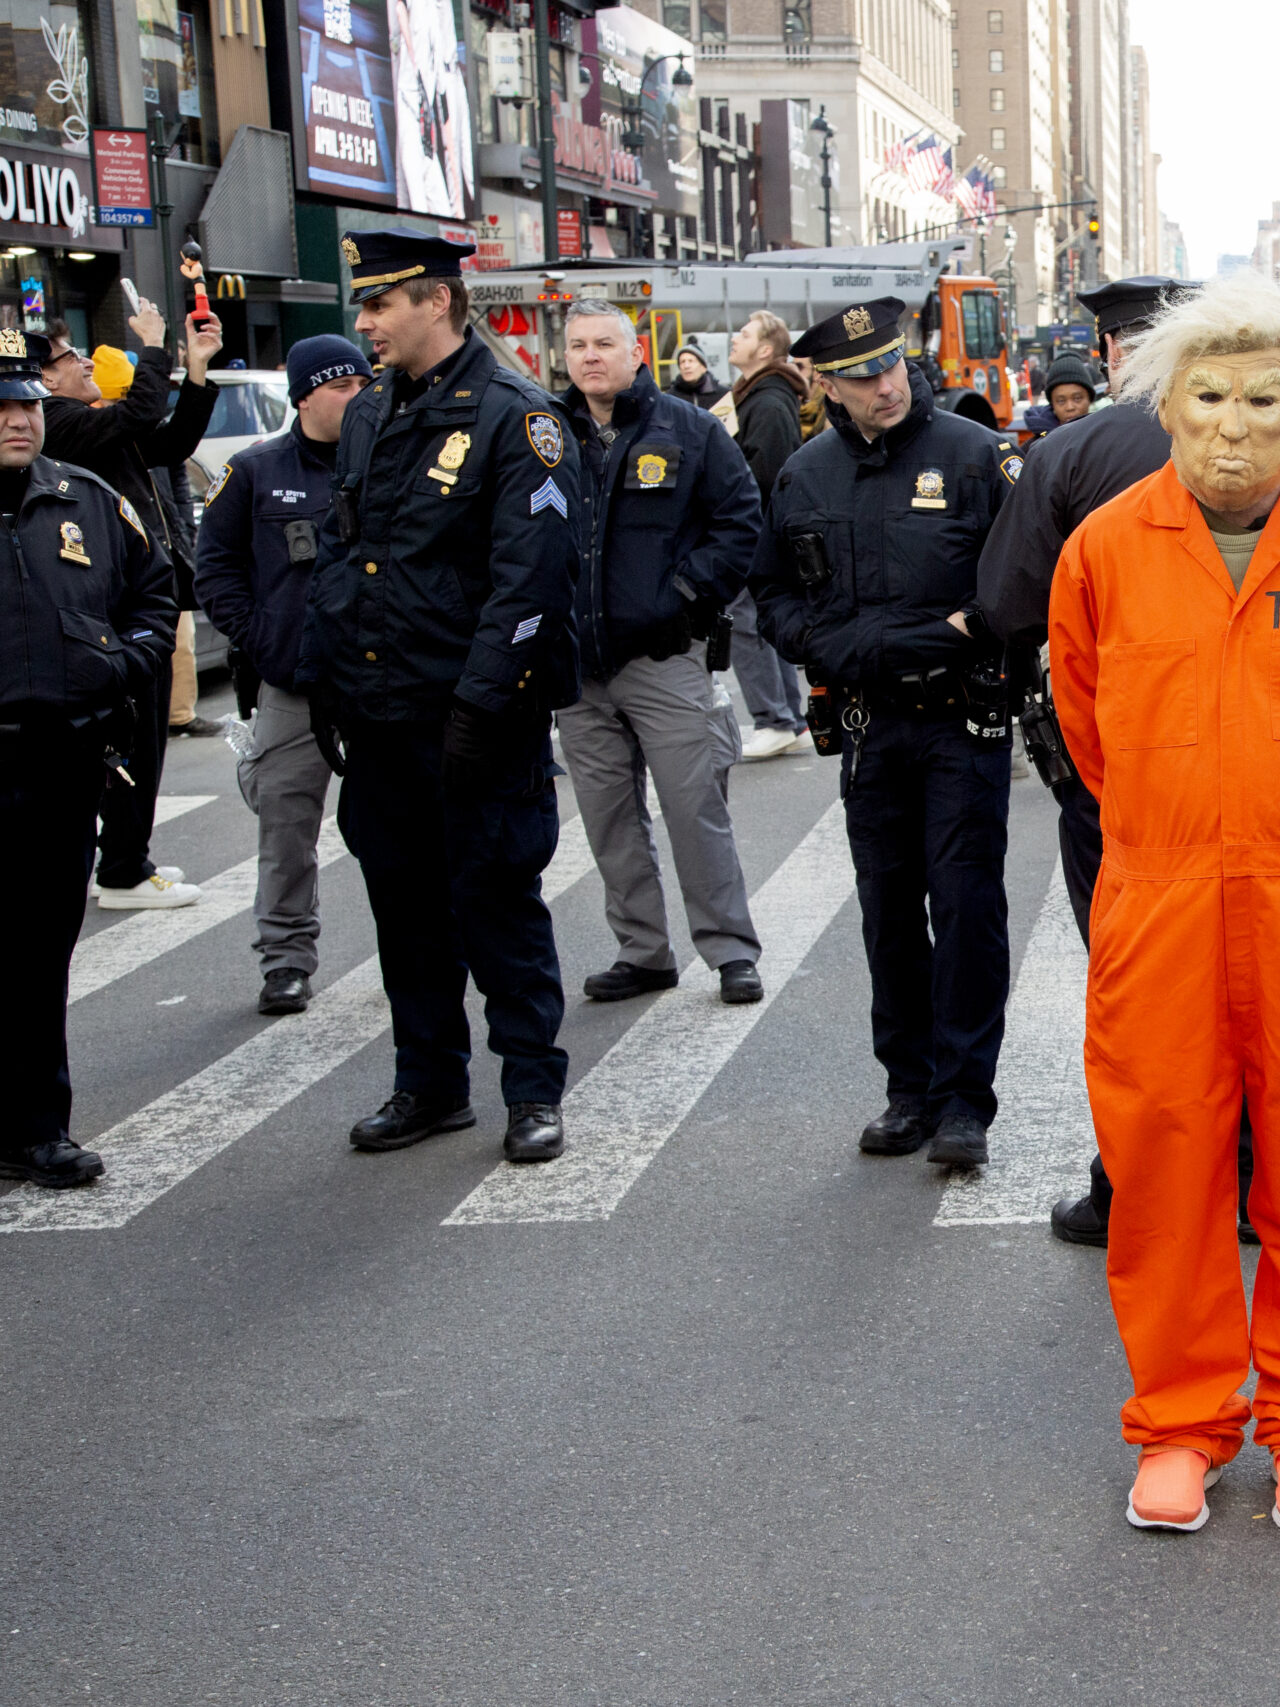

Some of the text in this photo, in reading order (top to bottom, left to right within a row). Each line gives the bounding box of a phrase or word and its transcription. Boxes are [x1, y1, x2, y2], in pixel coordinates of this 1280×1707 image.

[311, 85, 375, 130] OPENING WEEK:
[5, 108, 38, 133] DINING
[315, 125, 340, 158] APRIL
[103, 167, 141, 176] Commercial
[127, 175, 144, 185] Only
[101, 213, 133, 224] 104357
[832, 274, 873, 288] sanitation
[471, 286, 524, 301] 38AH-001
[310, 364, 356, 387] NYPD
